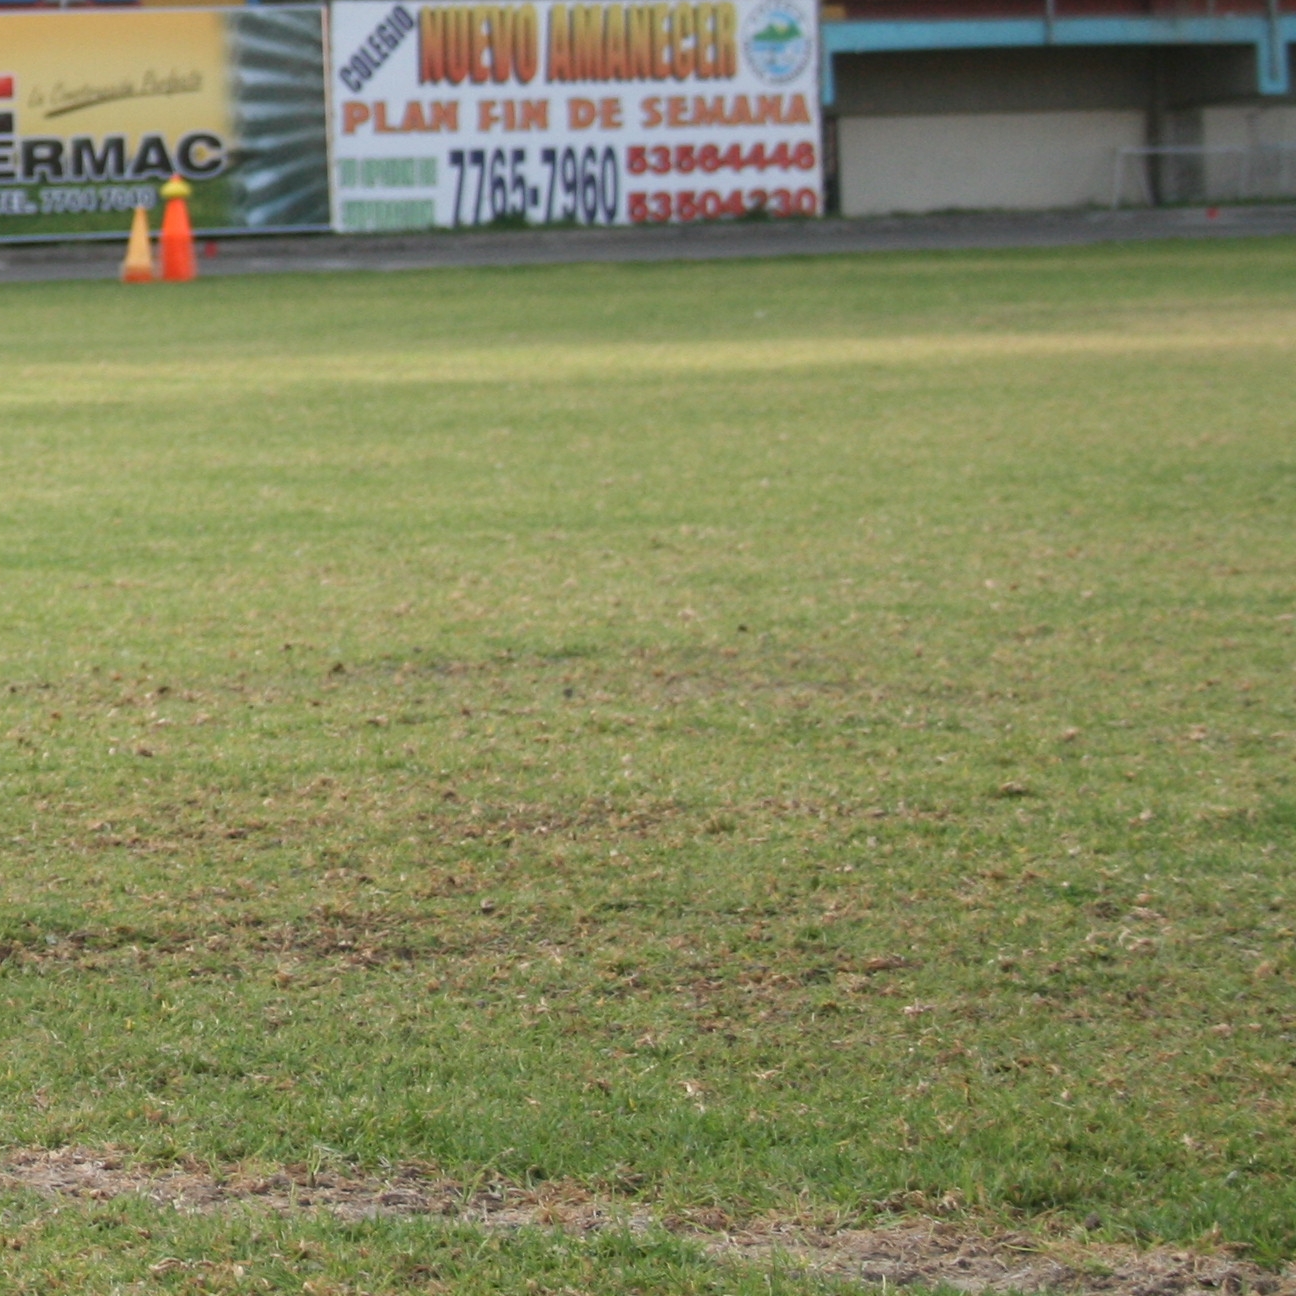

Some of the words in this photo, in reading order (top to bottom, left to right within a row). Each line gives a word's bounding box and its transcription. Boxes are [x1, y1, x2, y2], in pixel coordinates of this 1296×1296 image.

[339, 4, 415, 94] COLEGIO
[417, 5, 540, 85] NUEVO
[546, 1, 739, 84] AMANECER
[342, 100, 459, 135] PLAN
[478, 100, 550, 133] FIN
[568, 96, 624, 130] DE
[642, 93, 813, 129] SEMANA
[448, 144, 621, 228] 7765-7960
